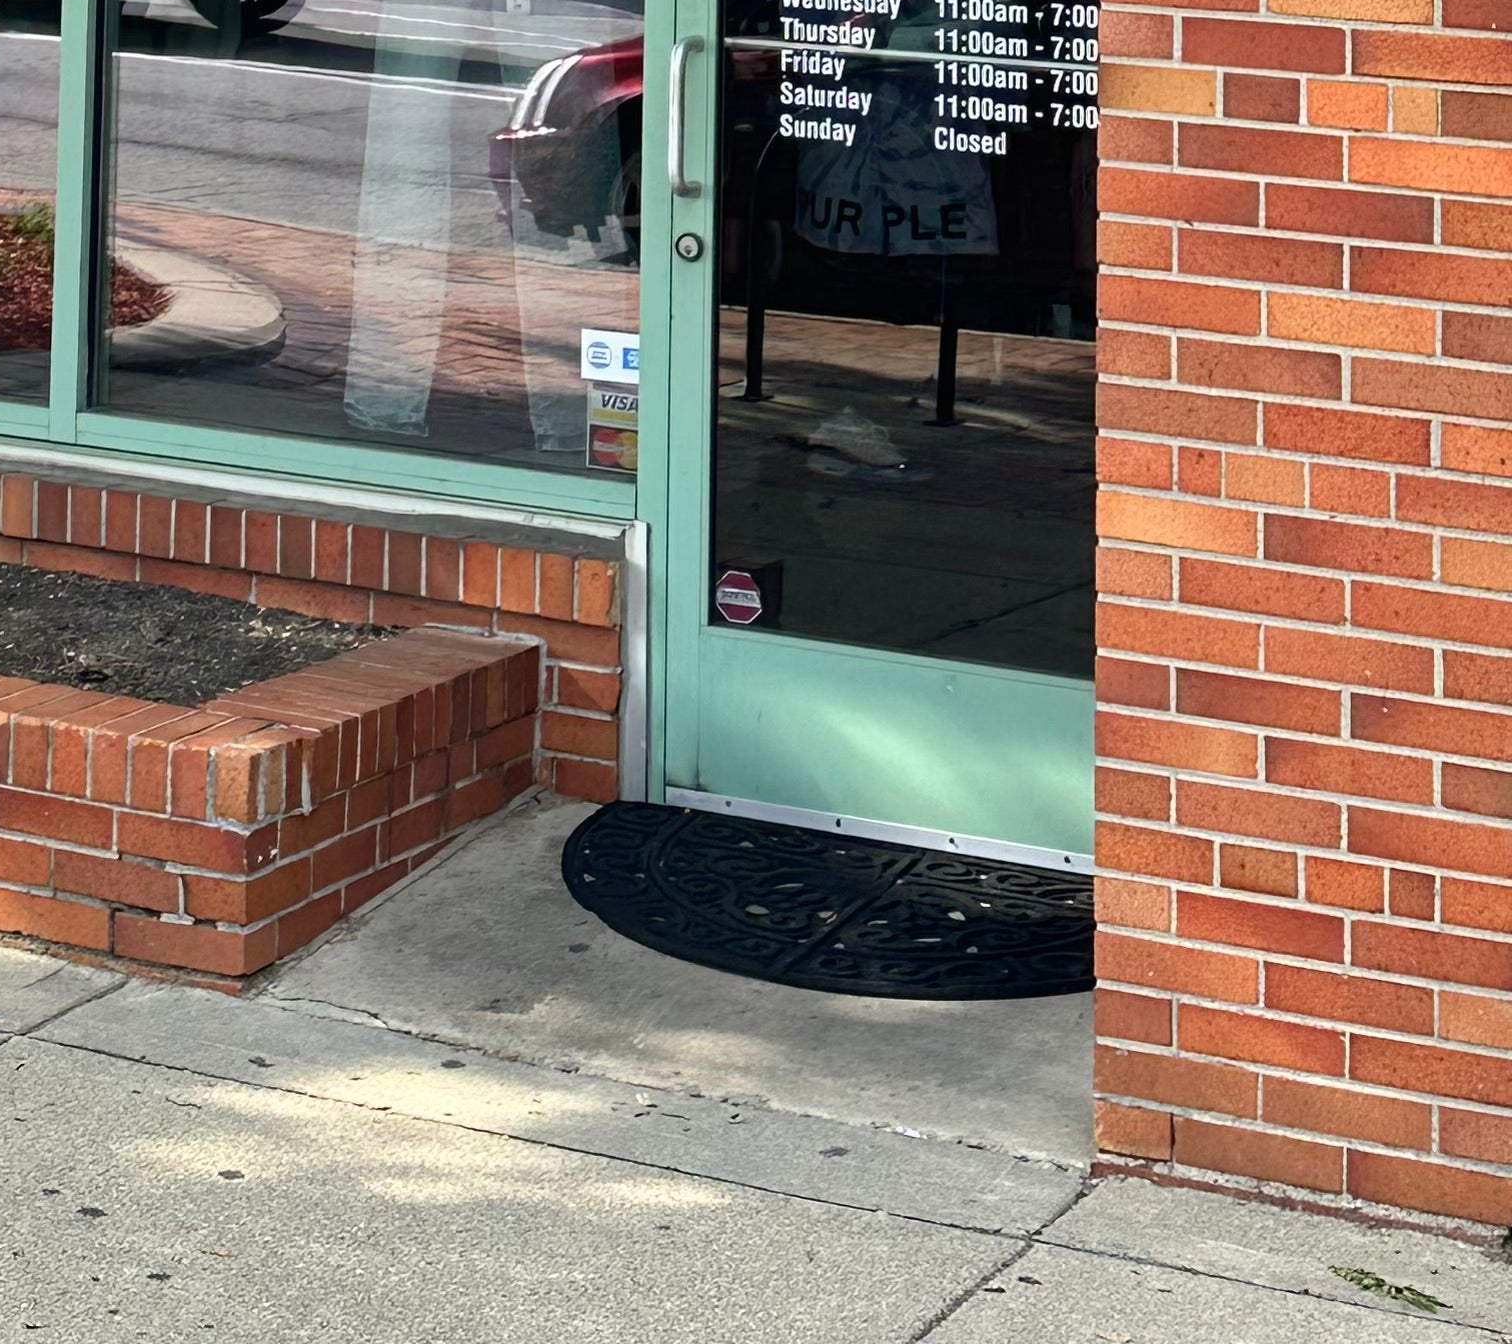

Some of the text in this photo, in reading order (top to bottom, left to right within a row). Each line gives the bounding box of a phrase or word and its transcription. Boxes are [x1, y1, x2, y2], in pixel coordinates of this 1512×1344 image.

[779, 16, 876, 50] Thursday
[935, 28, 1028, 57] 11:00am
[781, 48, 846, 80] Friday
[935, 61, 1028, 90] 11:00am
[781, 82, 872, 115] Saturday
[935, 94, 1028, 123] 11:00am
[780, 114, 1006, 154] Sunday Closed
